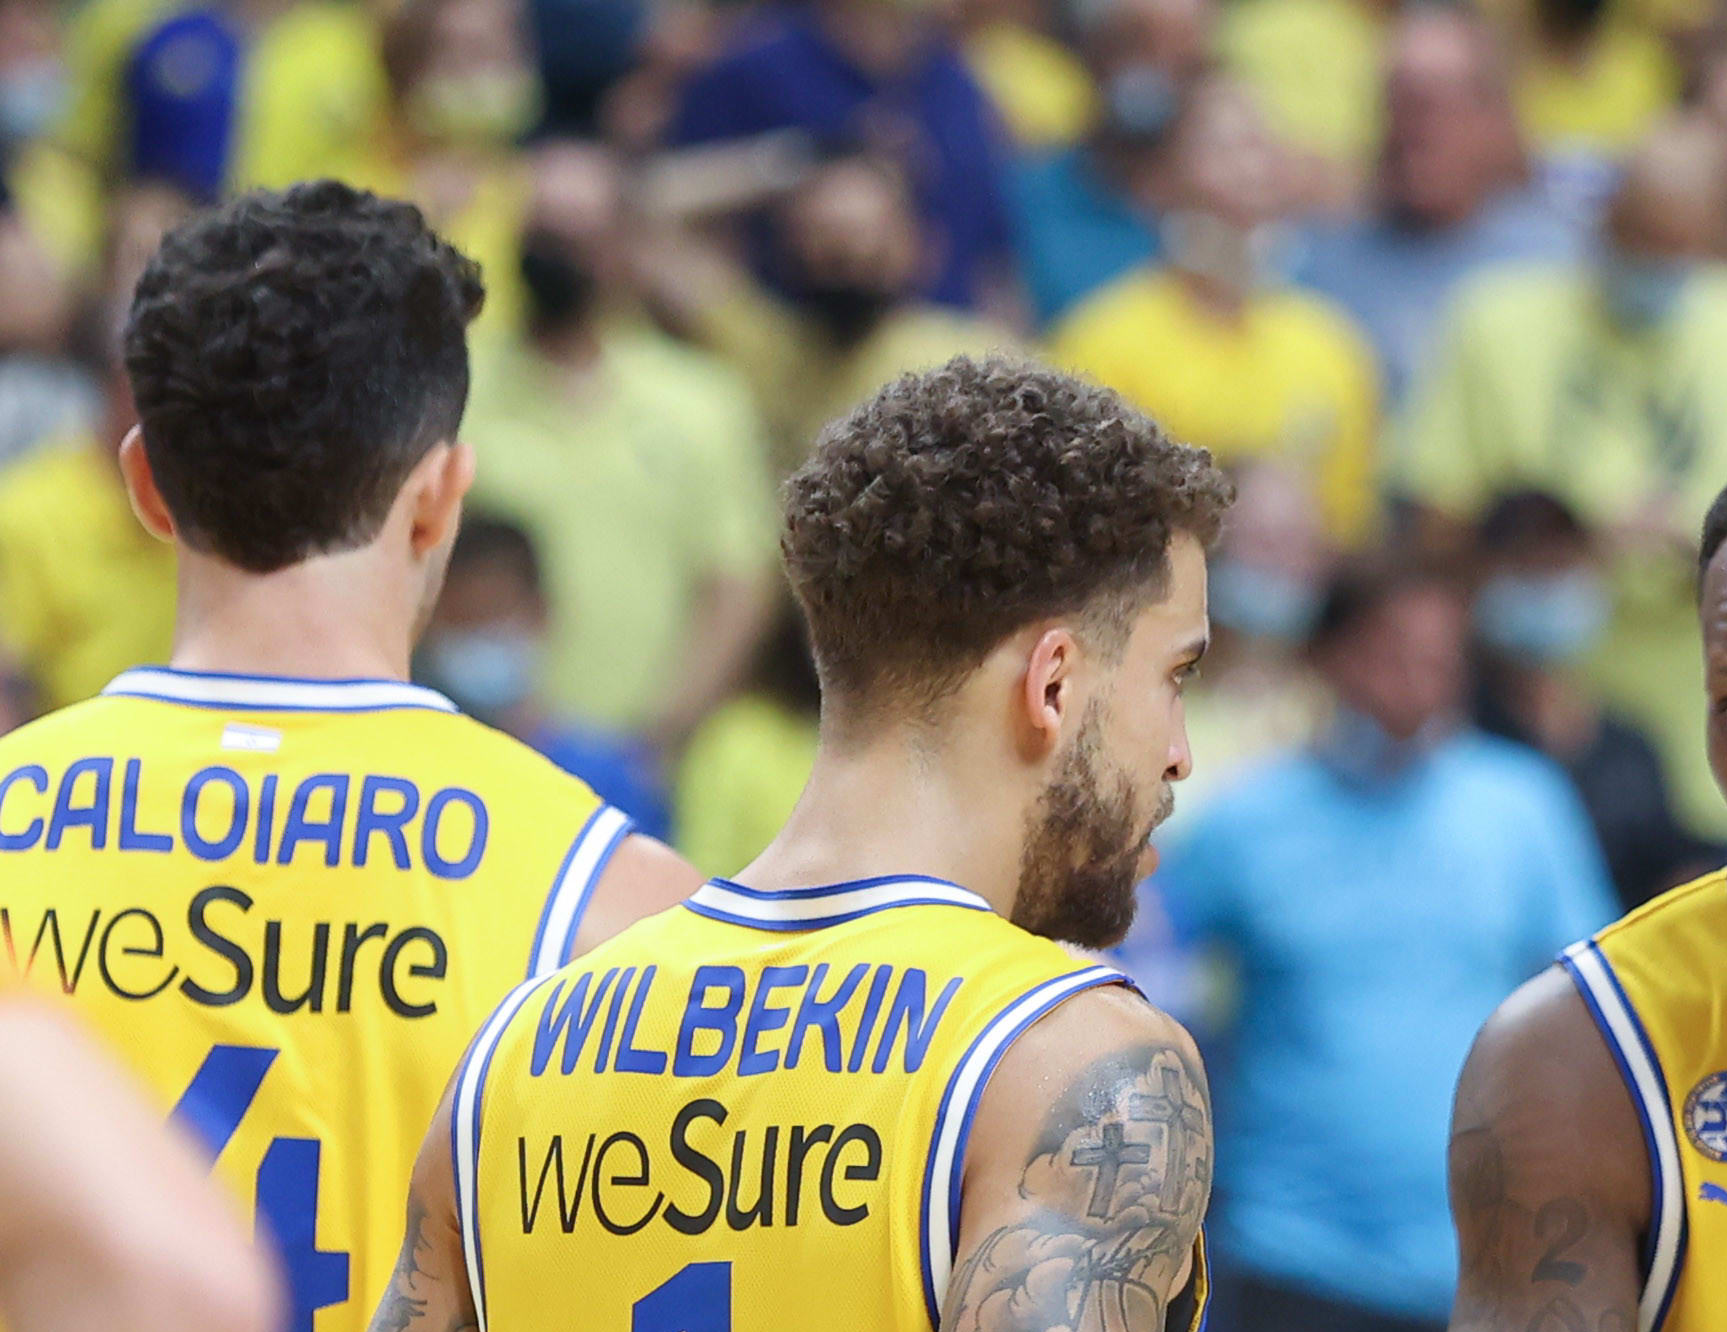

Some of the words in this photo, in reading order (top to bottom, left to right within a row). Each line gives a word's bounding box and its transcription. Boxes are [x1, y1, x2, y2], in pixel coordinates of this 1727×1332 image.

[0, 756, 489, 880] CALOIARO
[0, 886, 449, 1020] weSure
[529, 963, 964, 1079] WILBEKIN
[517, 1097, 882, 1237] weSure
